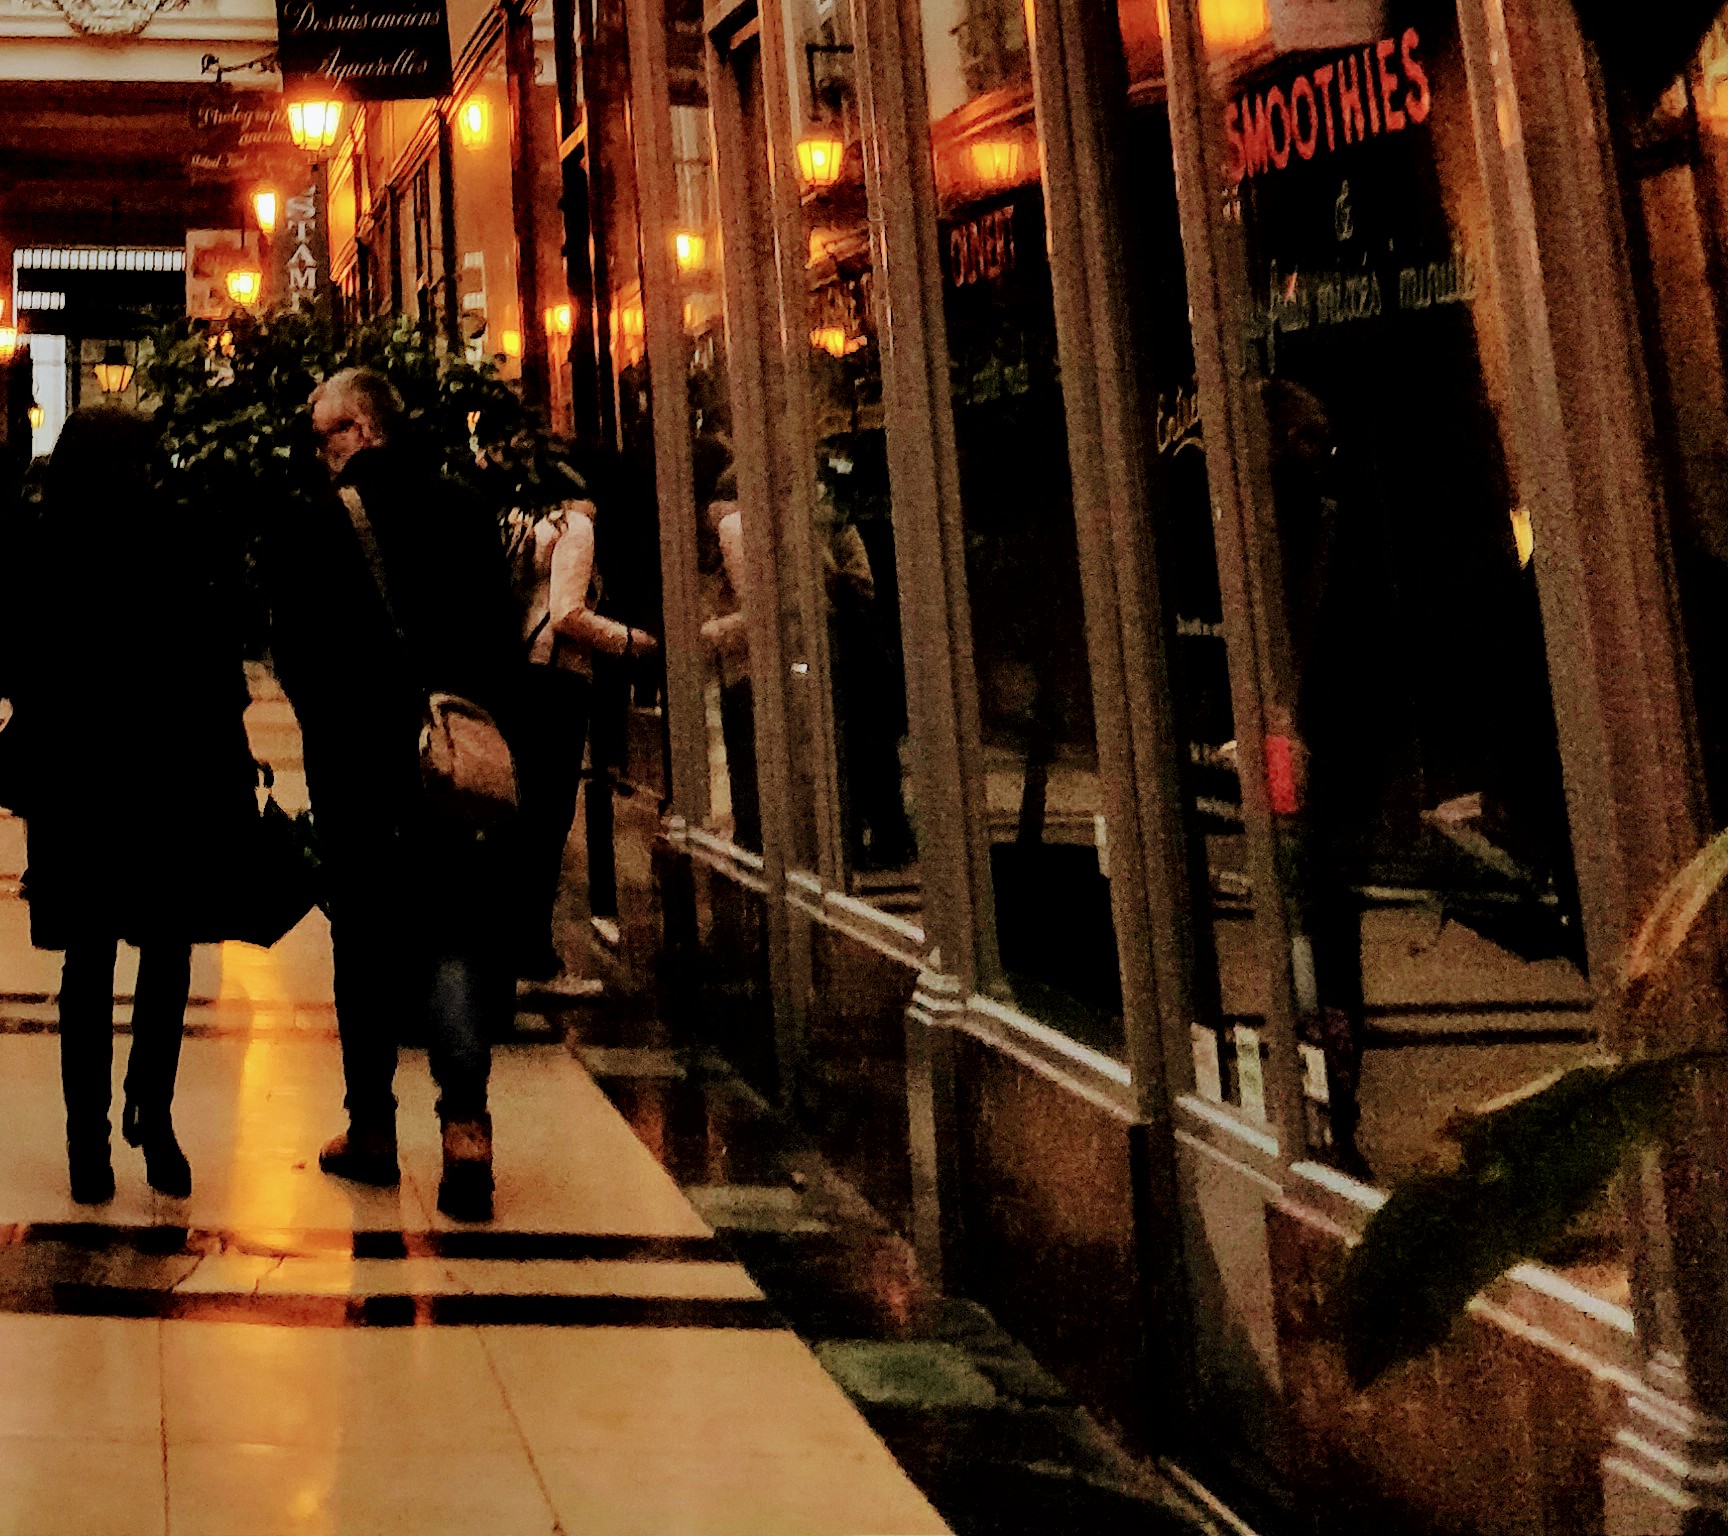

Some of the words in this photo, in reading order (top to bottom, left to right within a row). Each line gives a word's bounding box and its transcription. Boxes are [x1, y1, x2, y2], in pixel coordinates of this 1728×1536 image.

[283, 0, 370, 33] Dessins
[370, 2, 441, 29] anciens
[318, 45, 429, 92] Aquarelles
[1224, 26, 1432, 182] SMOOTHIES
